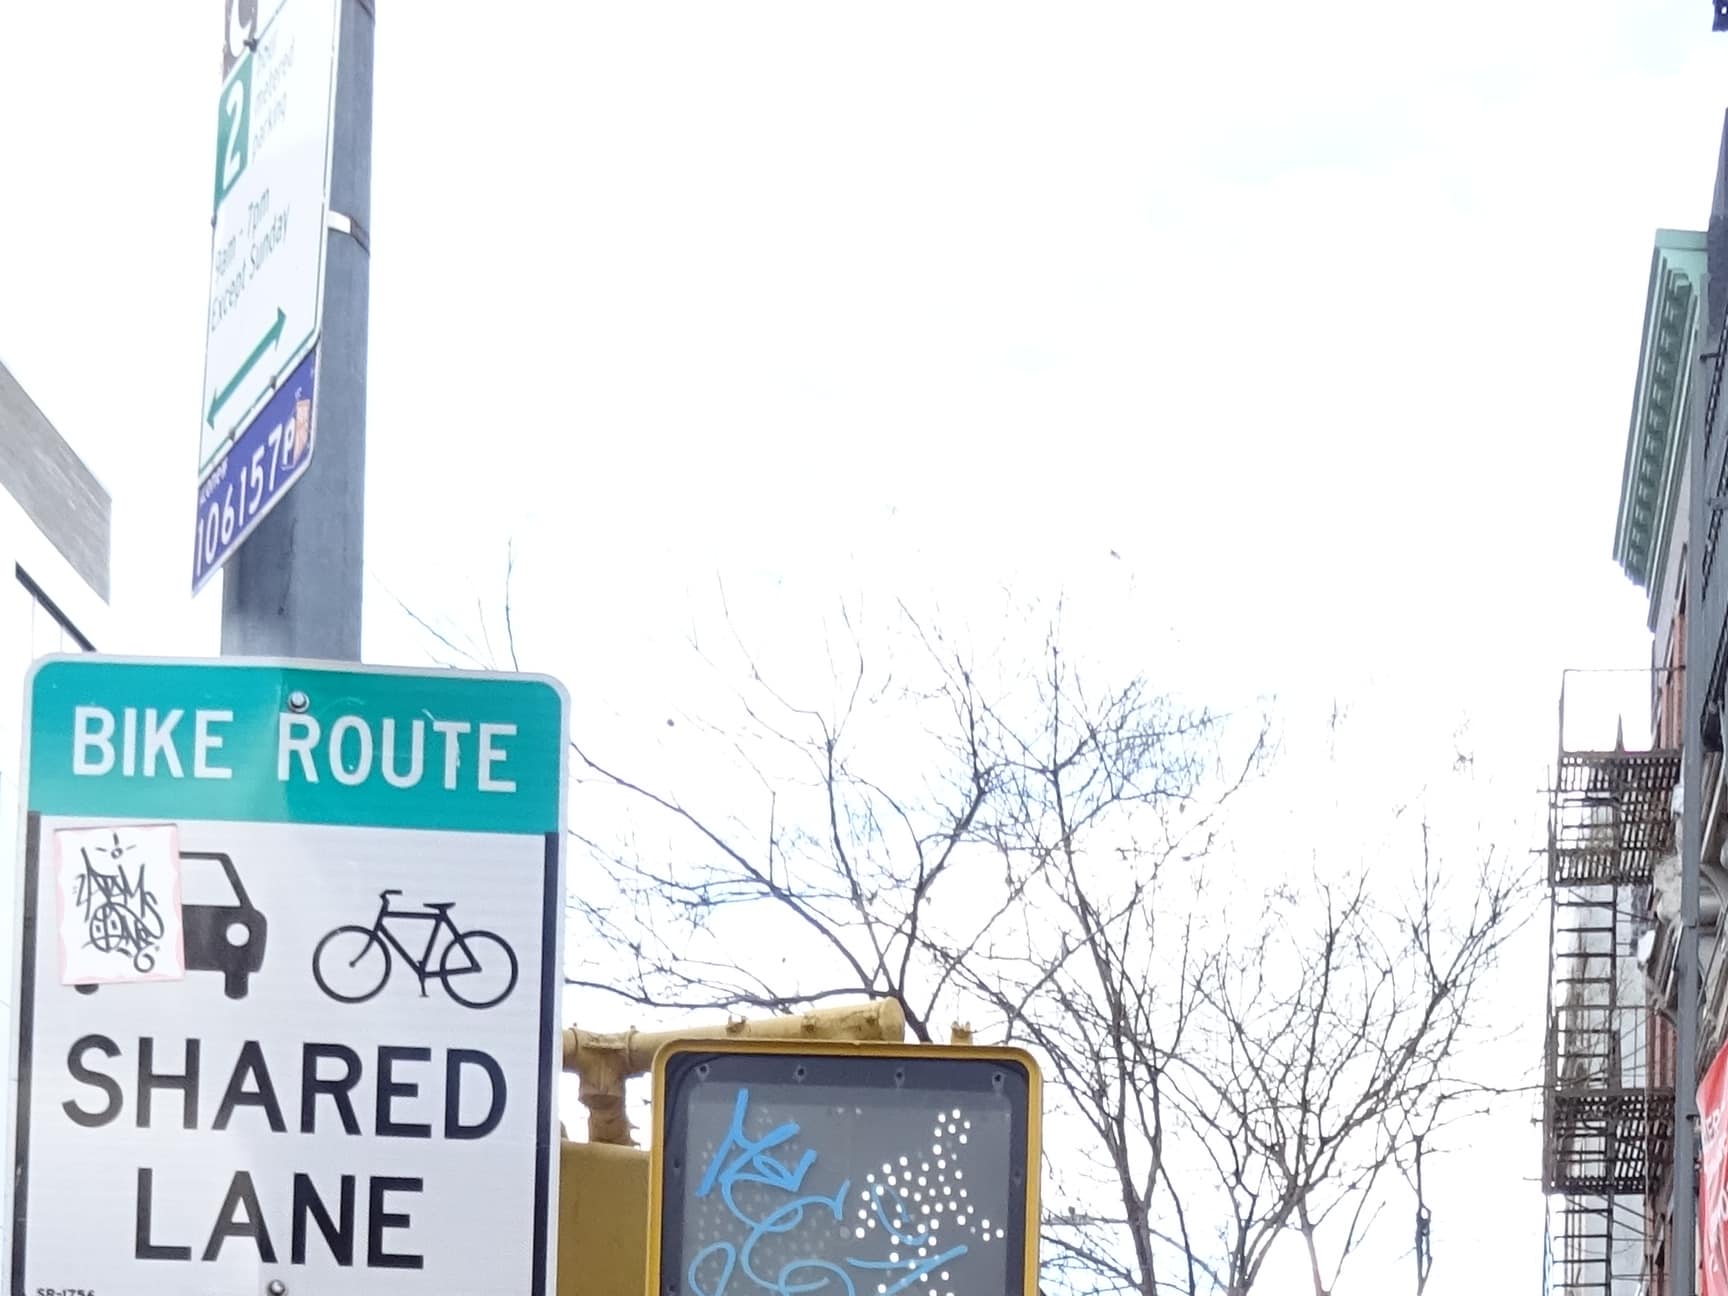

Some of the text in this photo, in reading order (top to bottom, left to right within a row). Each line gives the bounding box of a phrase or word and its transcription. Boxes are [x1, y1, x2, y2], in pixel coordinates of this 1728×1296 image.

[222, 79, 245, 192] 2
[74, 706, 519, 794] BIKE ROUTE
[61, 1034, 508, 1141] SHARED
[134, 1166, 425, 1270] LANE
